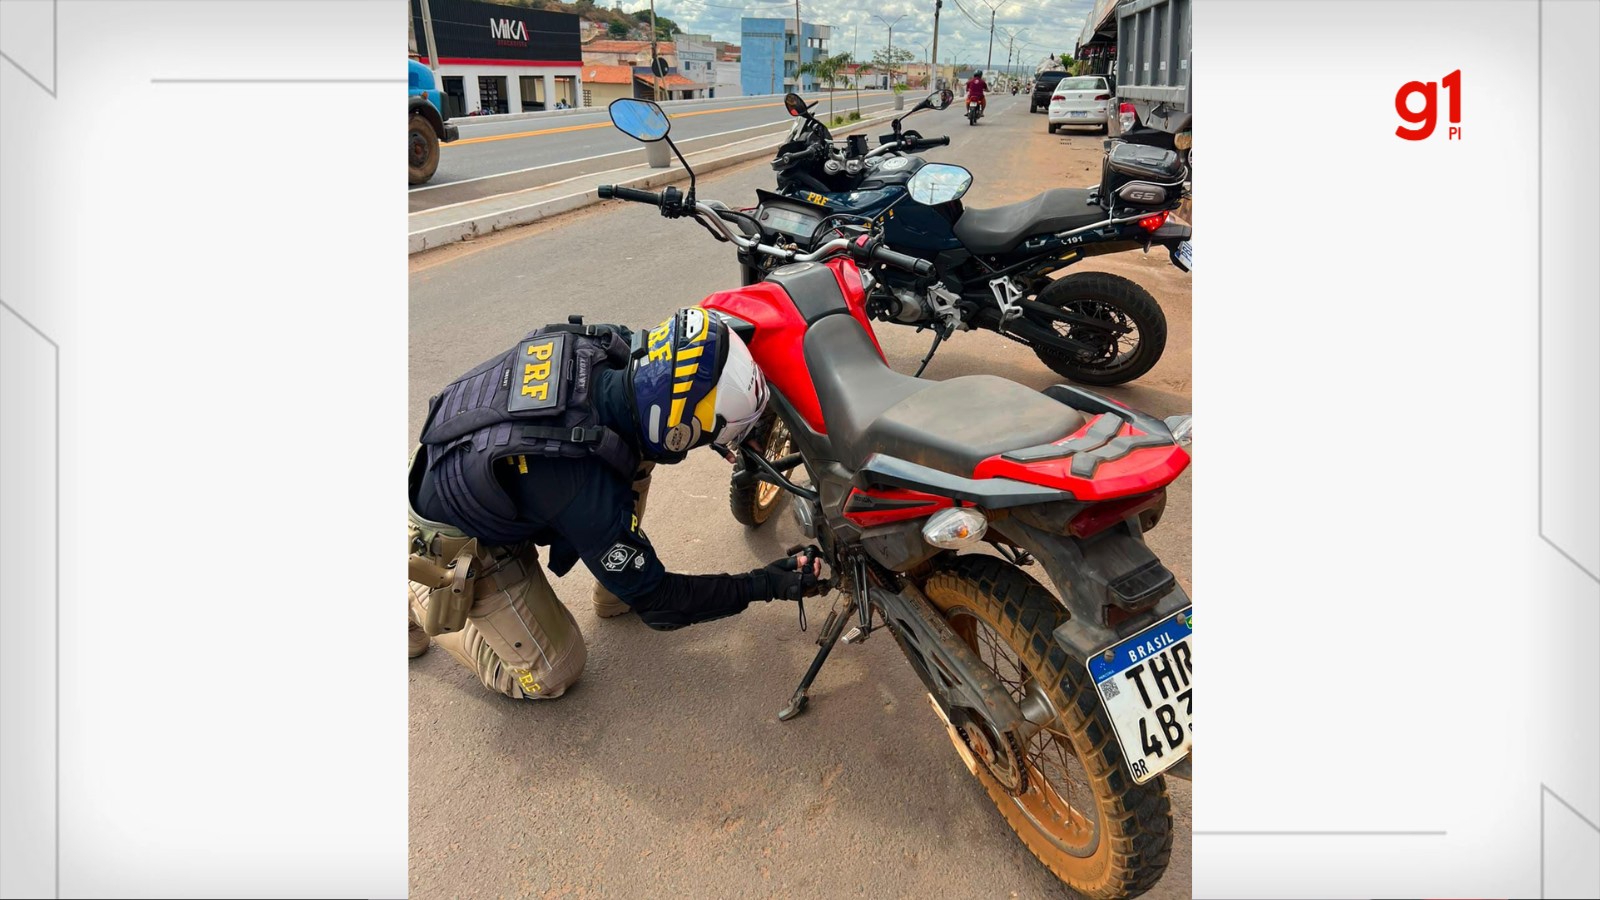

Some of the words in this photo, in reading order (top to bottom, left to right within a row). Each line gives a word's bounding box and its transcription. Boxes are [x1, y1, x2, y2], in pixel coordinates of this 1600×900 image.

[807, 191, 829, 206] PRF
[1130, 191, 1156, 200] GS
[1067, 235, 1083, 245] 191
[648, 317, 673, 362] RF
[521, 341, 554, 401] PRF
[1128, 631, 1174, 663] BRASIL
[1132, 758, 1149, 779] BR
